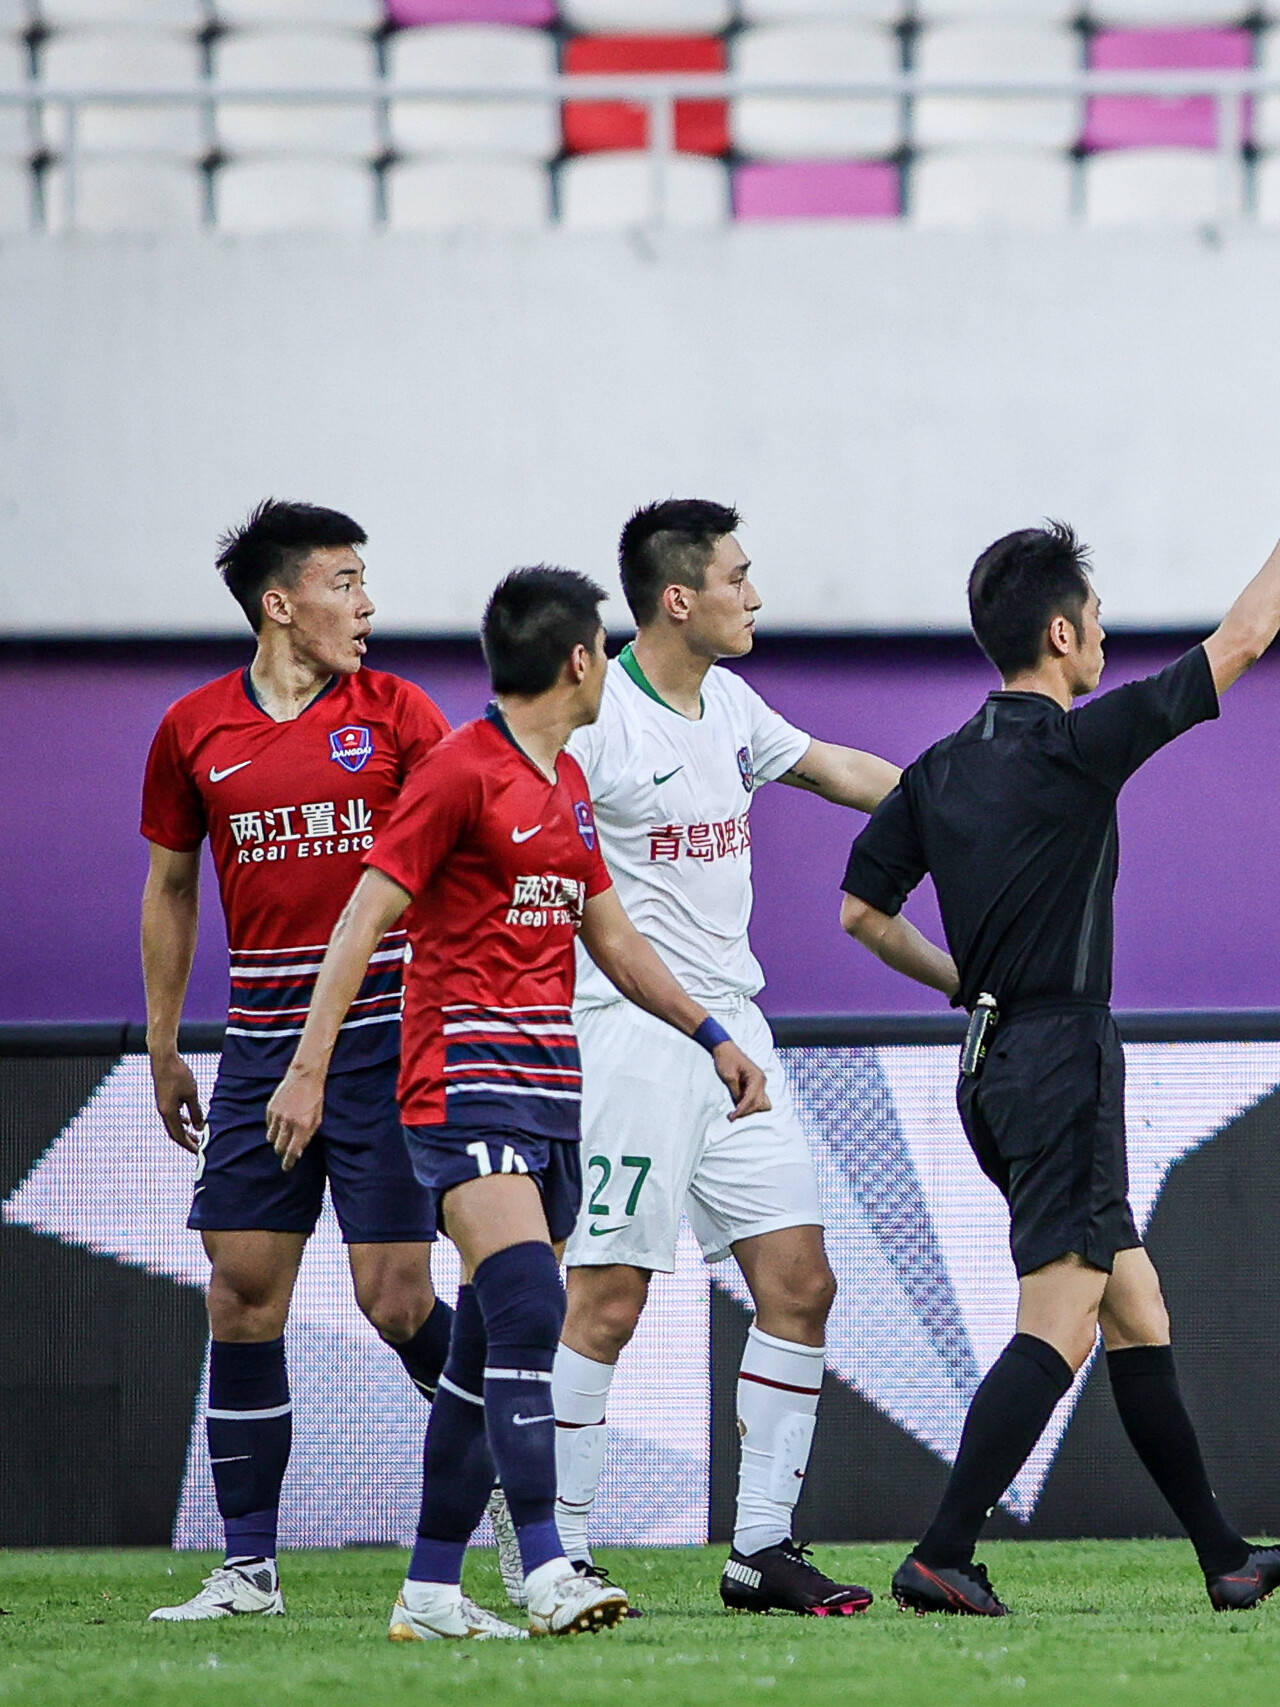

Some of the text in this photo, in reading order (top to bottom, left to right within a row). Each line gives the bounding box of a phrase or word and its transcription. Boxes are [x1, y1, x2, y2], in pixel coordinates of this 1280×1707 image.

[229, 798, 374, 846] 两江置业
[237, 834, 375, 864] Real Estate
[505, 908, 548, 928] Real
[588, 1154, 652, 1217] 27
[723, 1558, 763, 1590] PUMA
